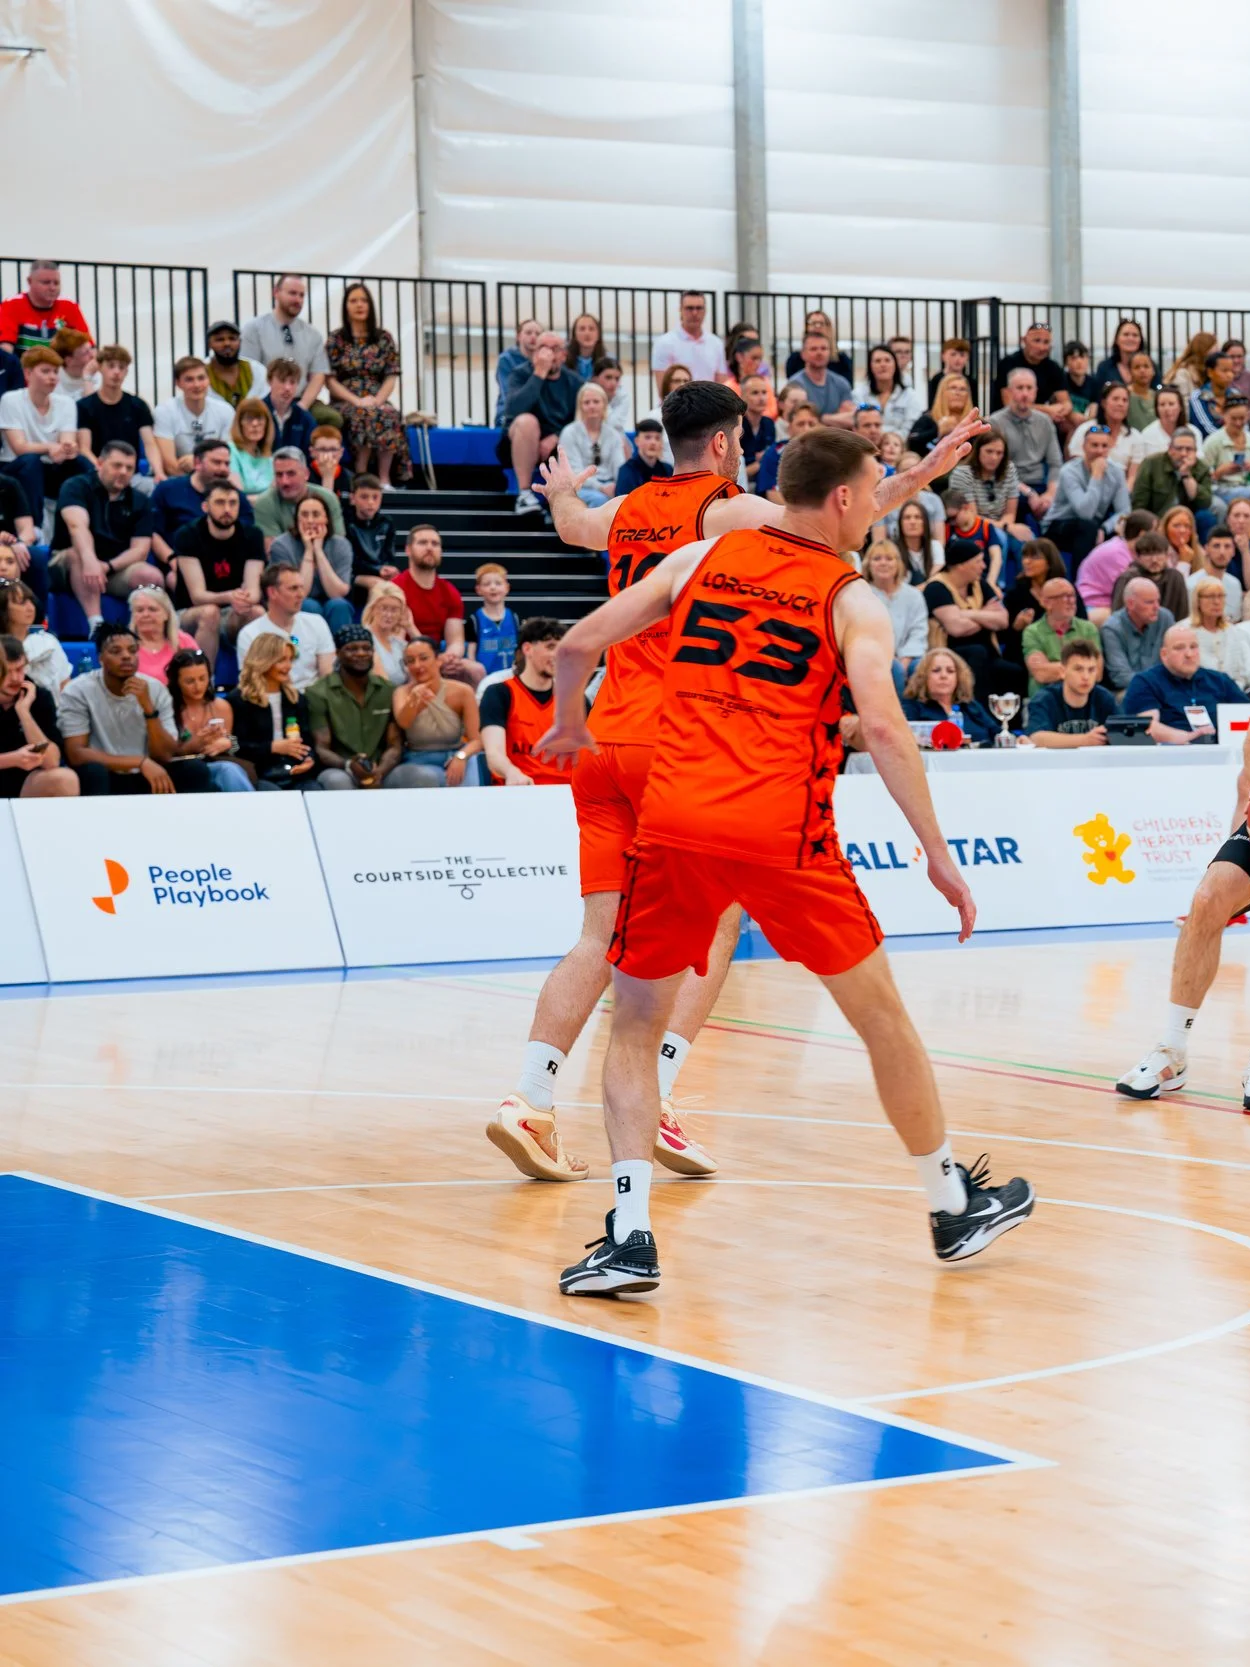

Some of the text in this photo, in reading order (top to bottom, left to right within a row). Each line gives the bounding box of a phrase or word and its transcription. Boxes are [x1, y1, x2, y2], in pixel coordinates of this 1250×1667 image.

[615, 525, 683, 543] TREACY
[671, 599, 821, 686] 53
[1136, 832, 1223, 848] HEARTBEAT
[444, 856, 473, 865] THE
[846, 836, 1022, 870] ALL TAR
[1142, 850, 1192, 865] TRUST
[148, 863, 232, 886] People
[353, 865, 568, 883] COURTSIDE COLLECTIVE
[153, 882, 270, 907] Playbook
